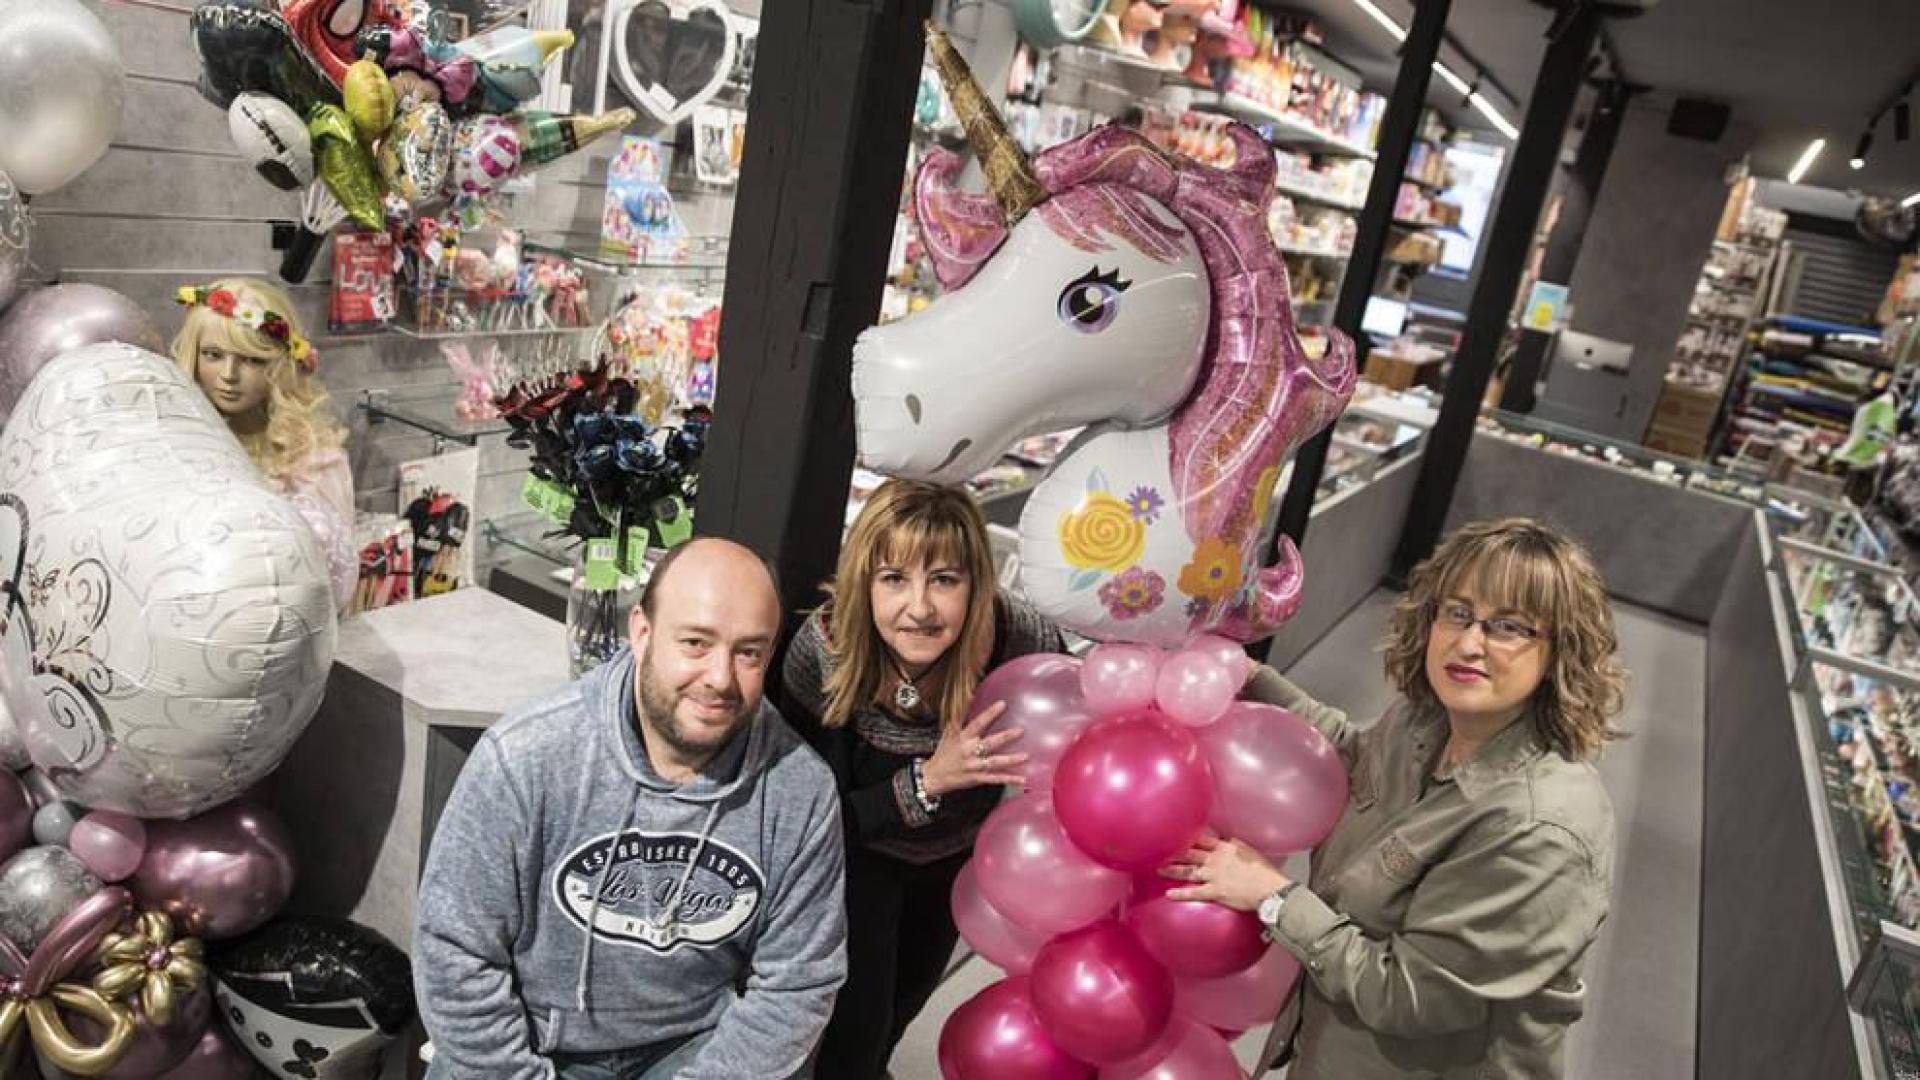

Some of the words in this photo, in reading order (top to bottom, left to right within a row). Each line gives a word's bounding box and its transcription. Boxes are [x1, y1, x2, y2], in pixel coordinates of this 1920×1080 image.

[582, 841, 700, 871] ESTABISHE
[578, 869, 641, 908] Las
[654, 877, 739, 918] Vegas
